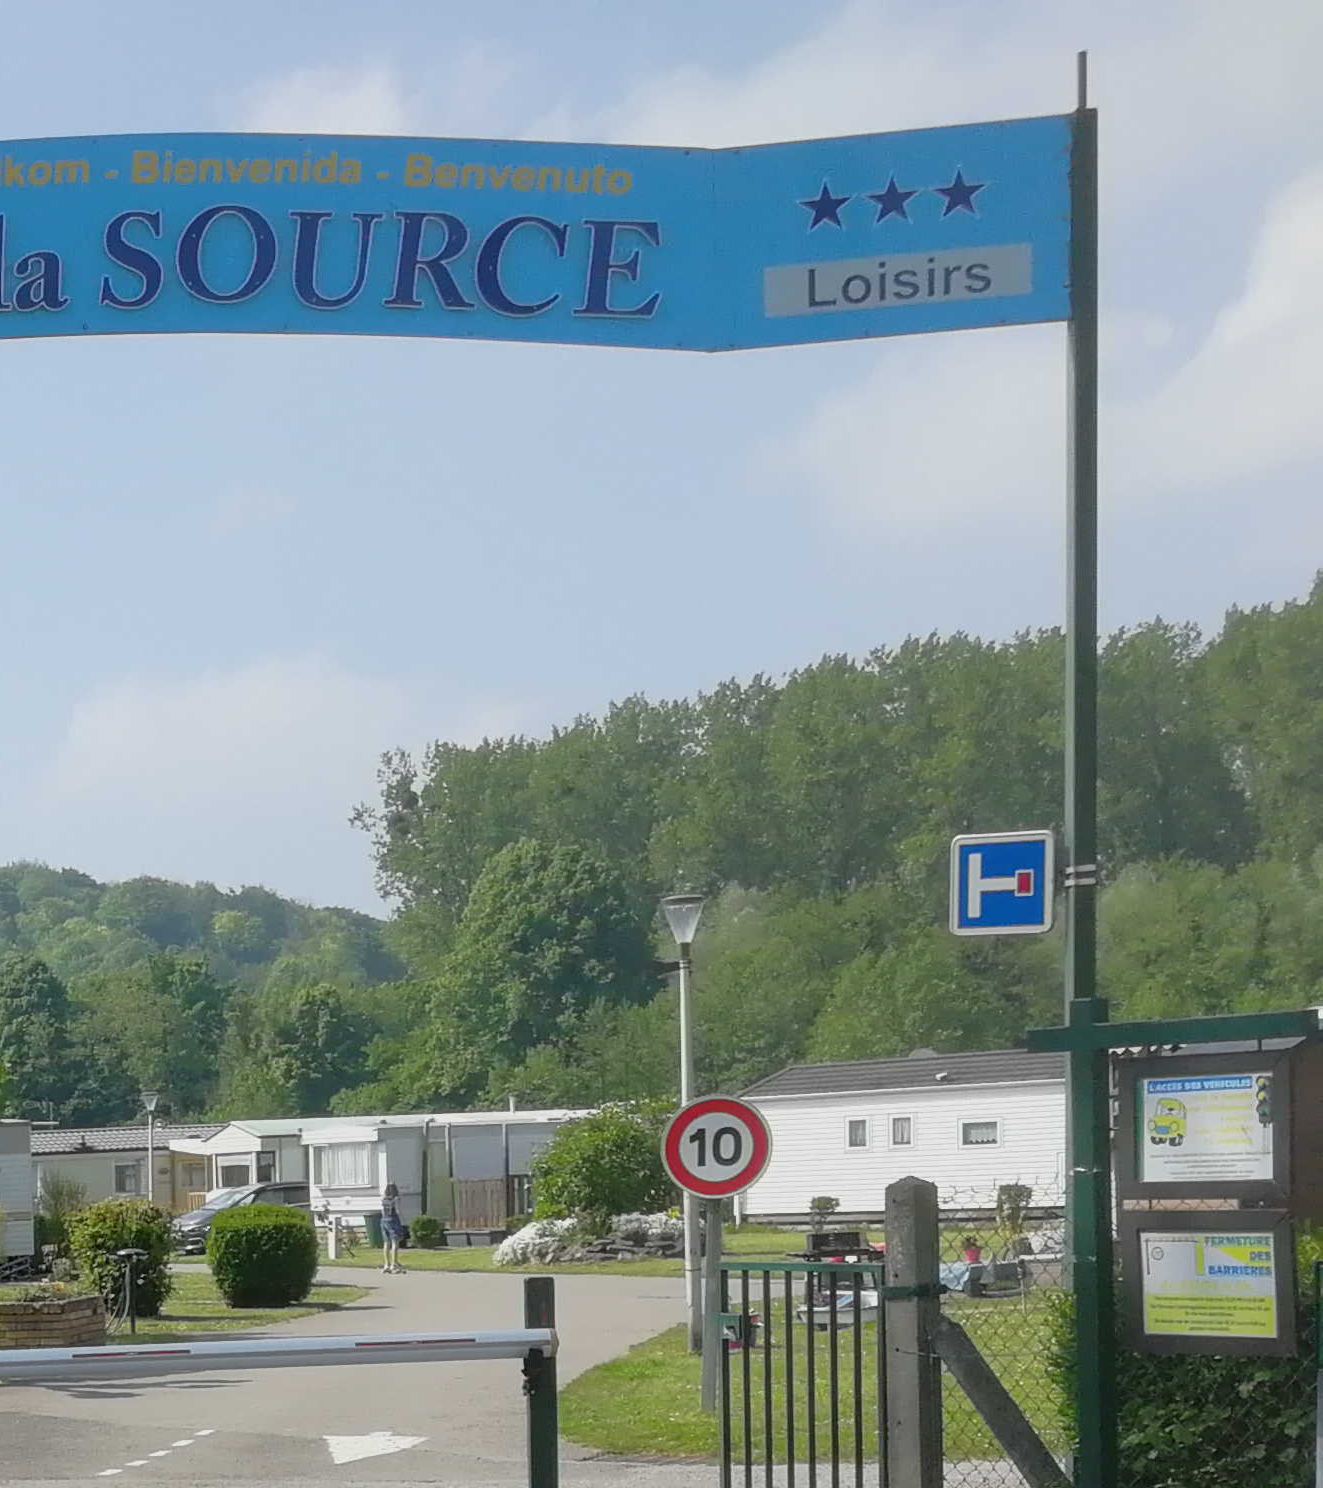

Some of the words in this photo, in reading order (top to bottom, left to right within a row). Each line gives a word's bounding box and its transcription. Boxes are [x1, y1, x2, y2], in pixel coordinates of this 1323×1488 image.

[131, 150, 363, 187] Bienvenida
[403, 153, 634, 196] Benvenuto
[99, 204, 663, 319] SOURCE
[807, 256, 993, 308] Loisirs
[689, 1126, 743, 1168] 10
[1249, 1251, 1272, 1261] DES
